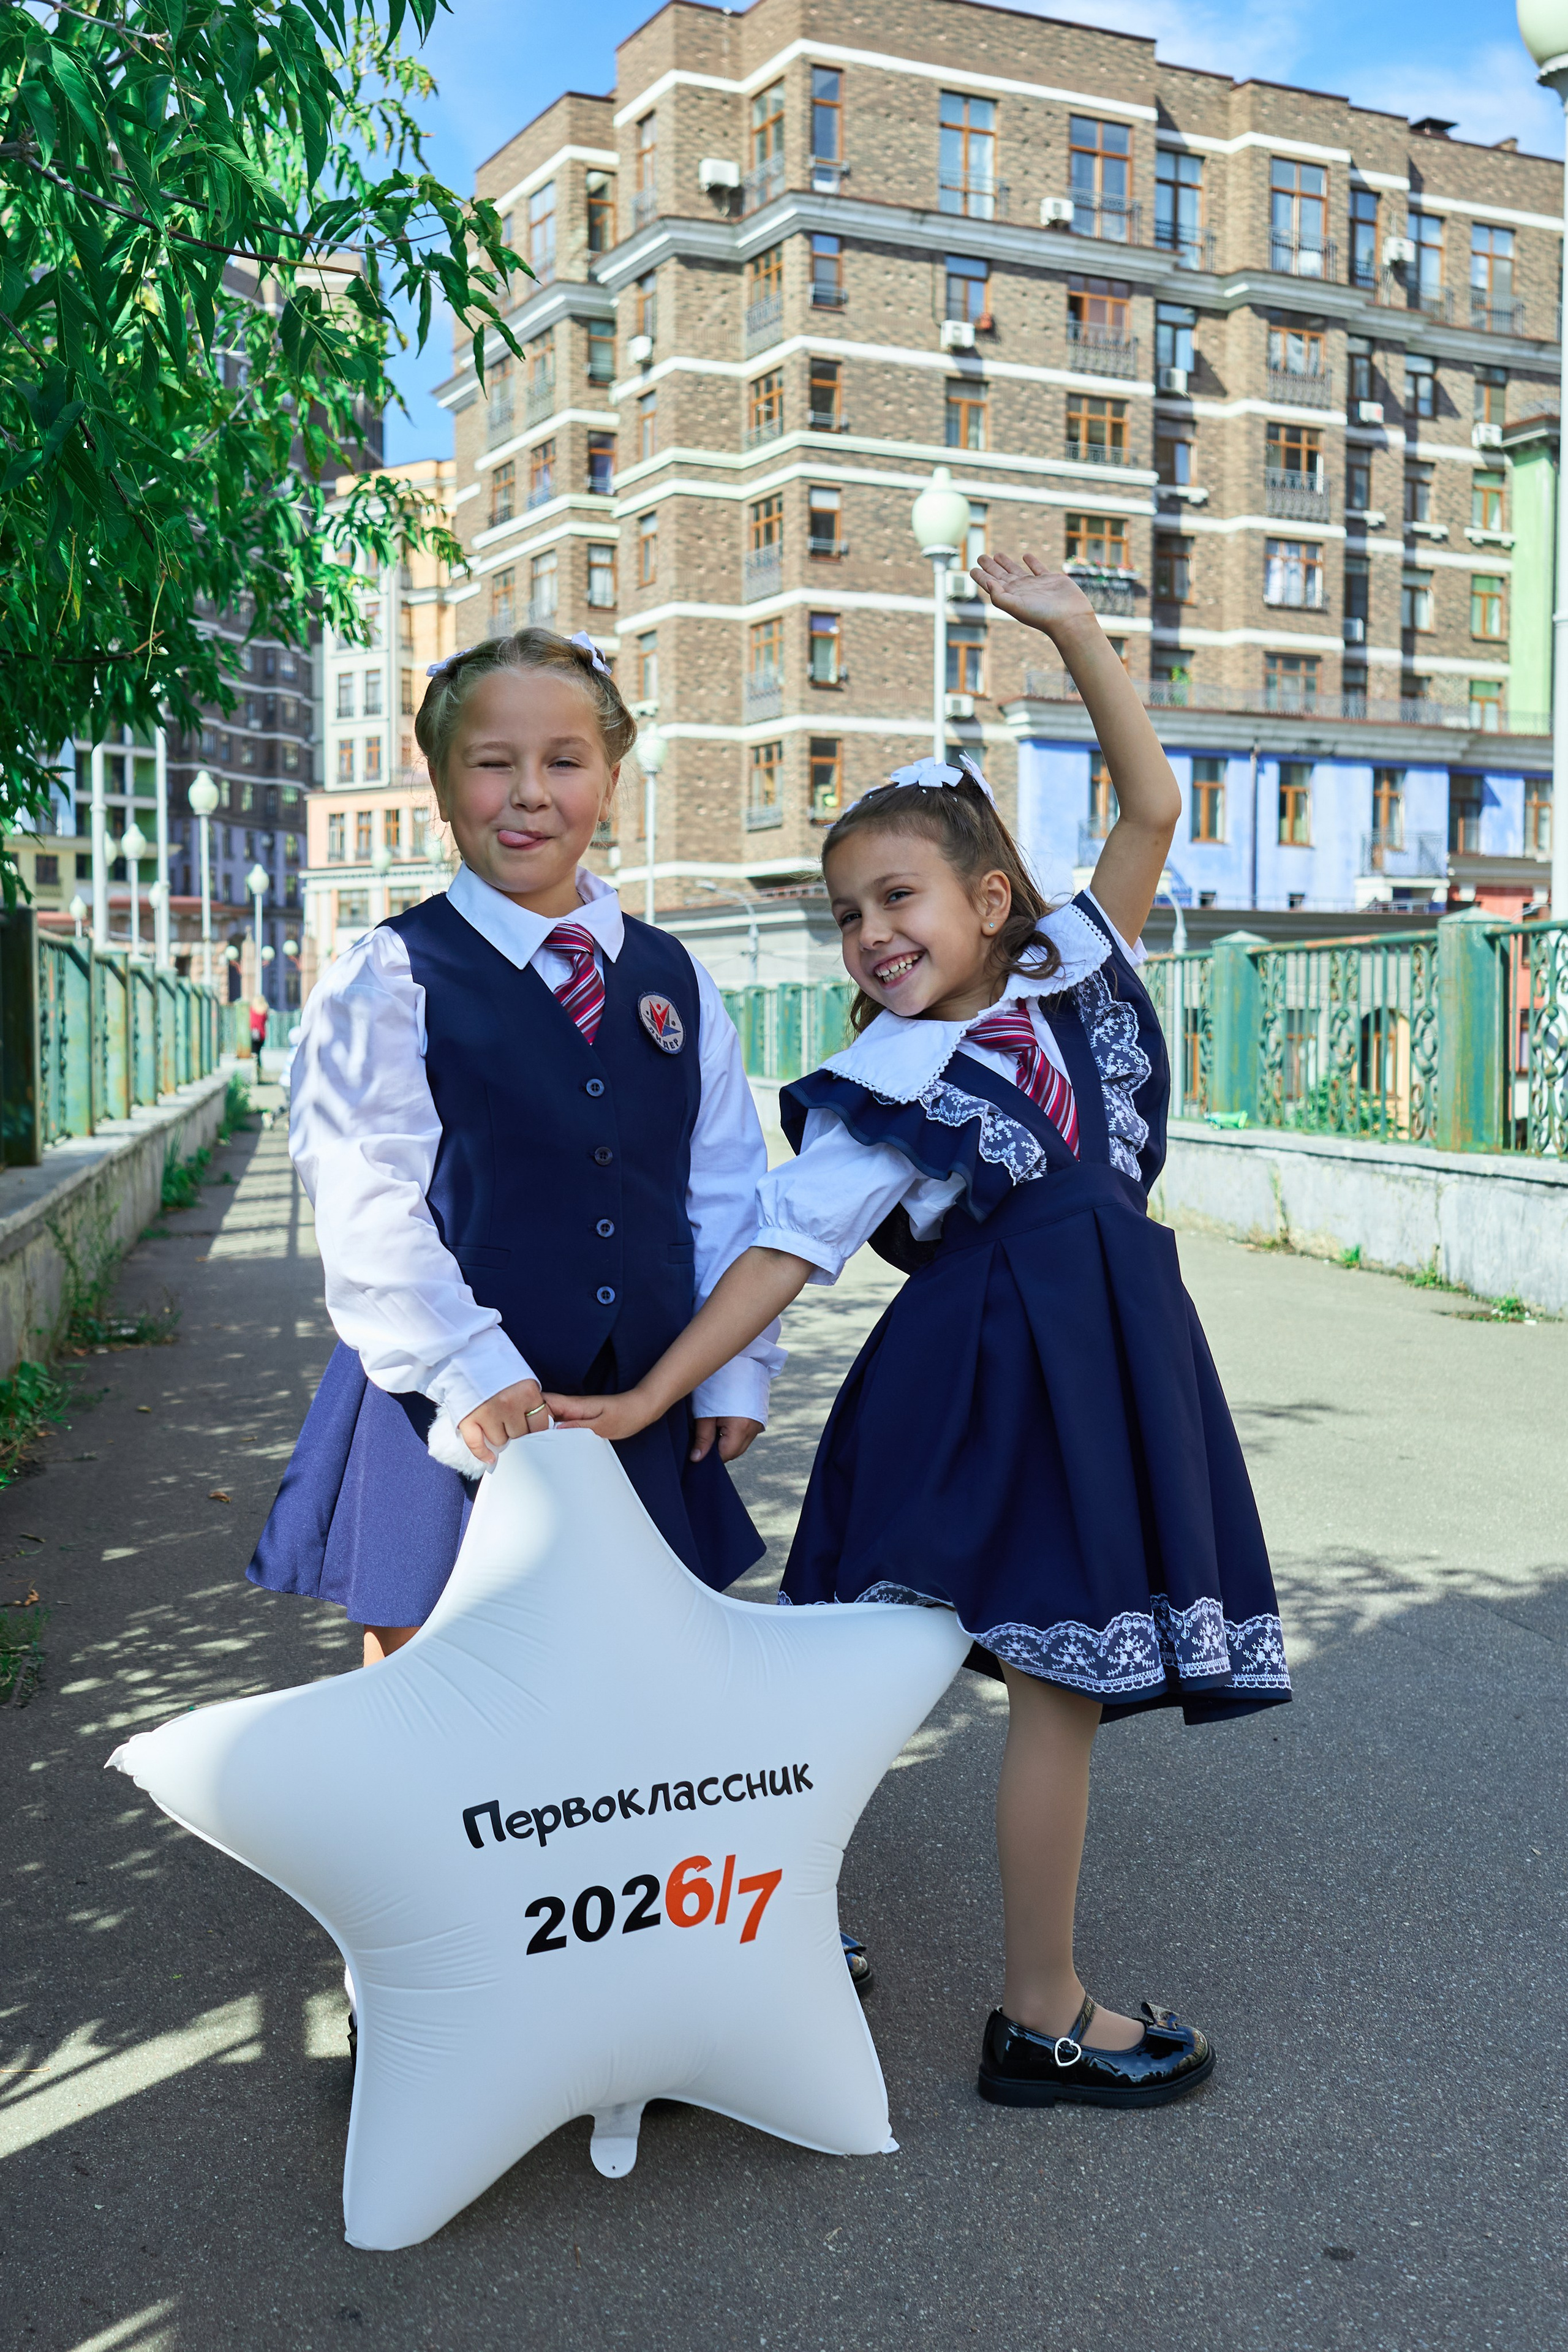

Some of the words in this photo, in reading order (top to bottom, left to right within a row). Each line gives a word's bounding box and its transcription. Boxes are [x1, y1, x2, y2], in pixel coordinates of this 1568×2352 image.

[648, 1026, 679, 1050] ЛИДЕР
[462, 1763, 813, 1849] Первоклассник
[524, 1854, 783, 1956] 2026/7
